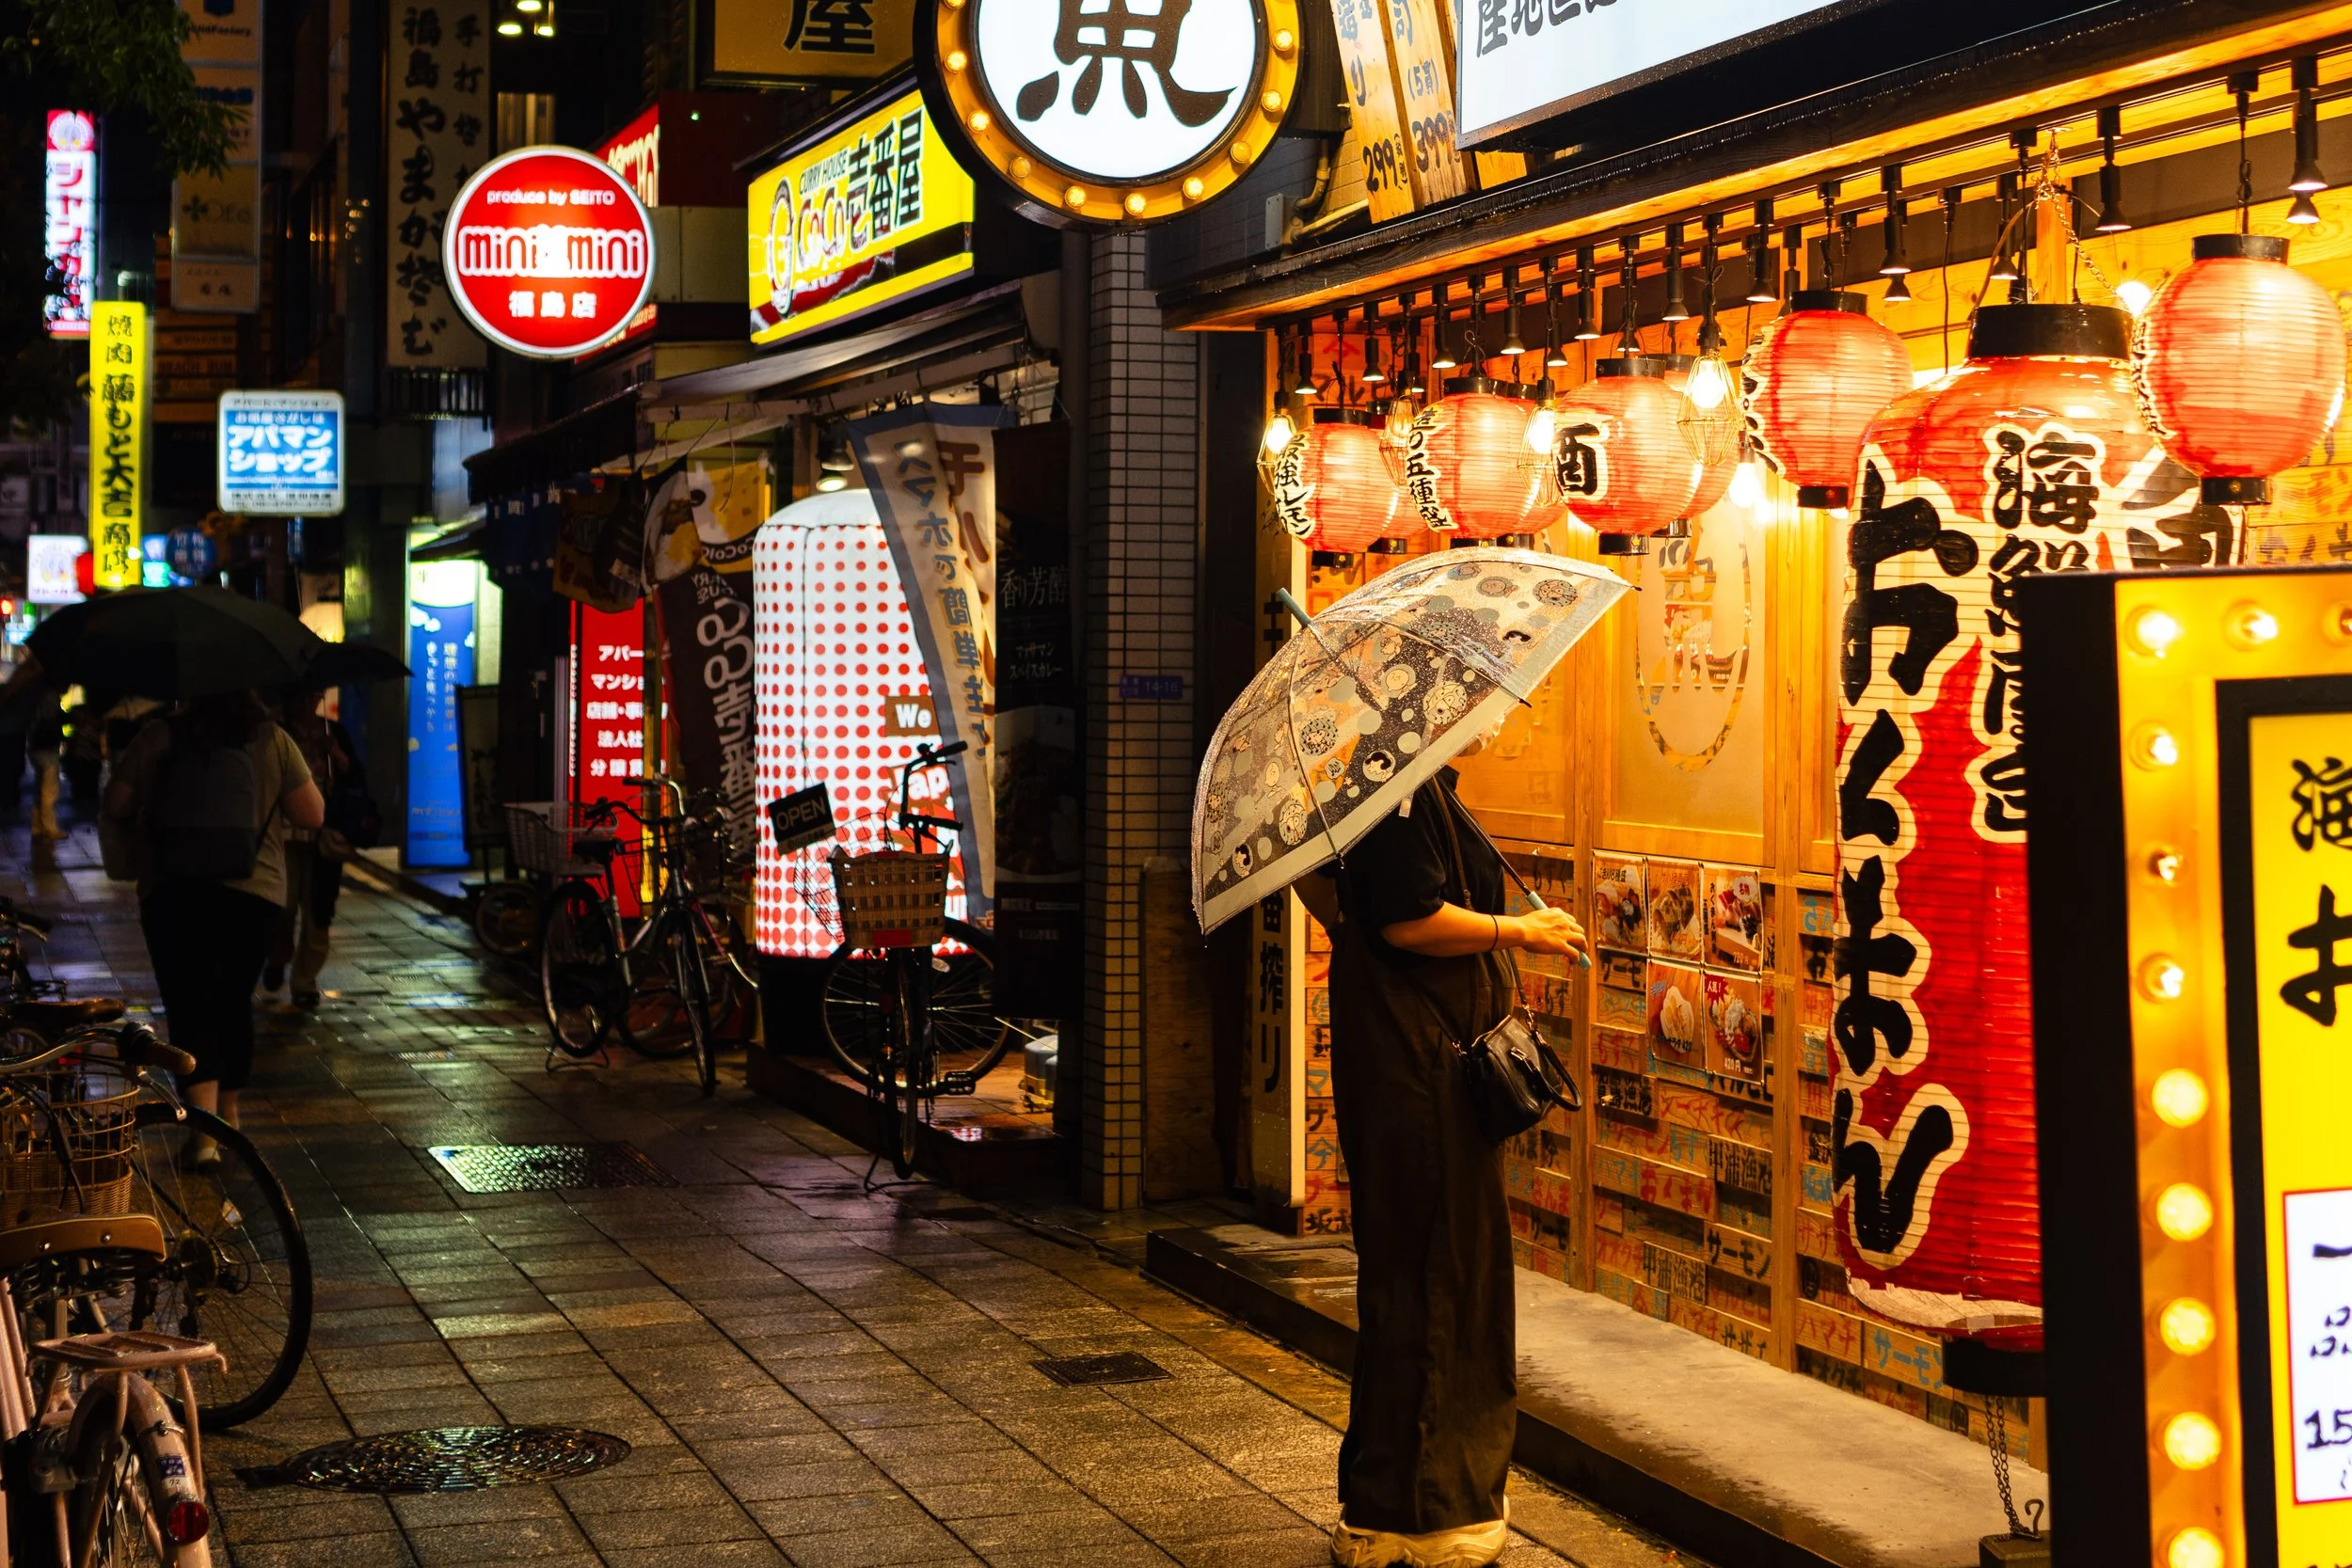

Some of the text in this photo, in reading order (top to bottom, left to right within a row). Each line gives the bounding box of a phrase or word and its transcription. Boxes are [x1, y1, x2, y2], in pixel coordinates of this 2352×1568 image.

[1017, 0, 1241, 127] 魚
[1412, 112, 1453, 173] 399
[800, 152, 848, 195] CURRY HOUSE
[1363, 138, 1397, 192] 299
[487, 189, 615, 206] produce by SEITO
[461, 229, 644, 277] mini mini
[509, 291, 596, 318] 福島店
[227, 423, 333, 449] アパマン
[228, 447, 333, 473] ショップ
[895, 703, 932, 729] We
[597, 730, 644, 749] 法人社
[775, 799, 827, 832] OPEN
[1707, 1227, 1771, 1279] サーモン
